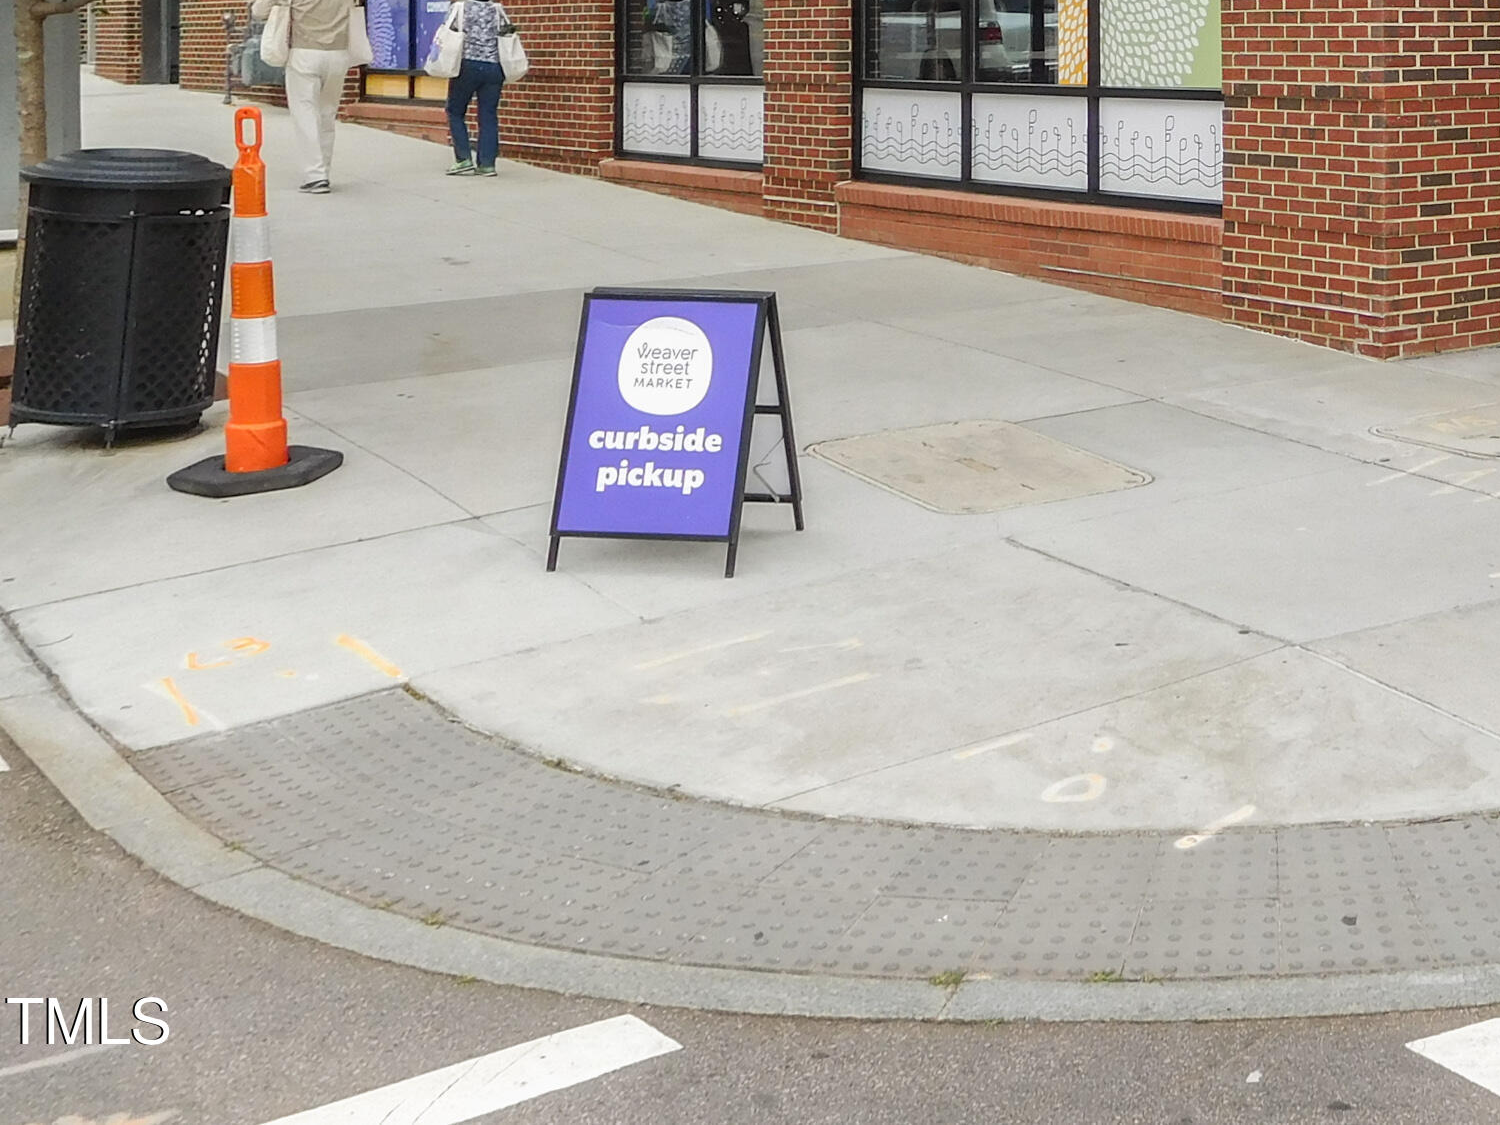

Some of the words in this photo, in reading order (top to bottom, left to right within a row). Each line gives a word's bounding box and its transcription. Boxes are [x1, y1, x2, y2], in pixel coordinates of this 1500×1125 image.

[640, 361, 690, 375] street
[633, 378, 693, 389] MARKET
[588, 425, 722, 452] curbside
[596, 459, 705, 495] pickup
